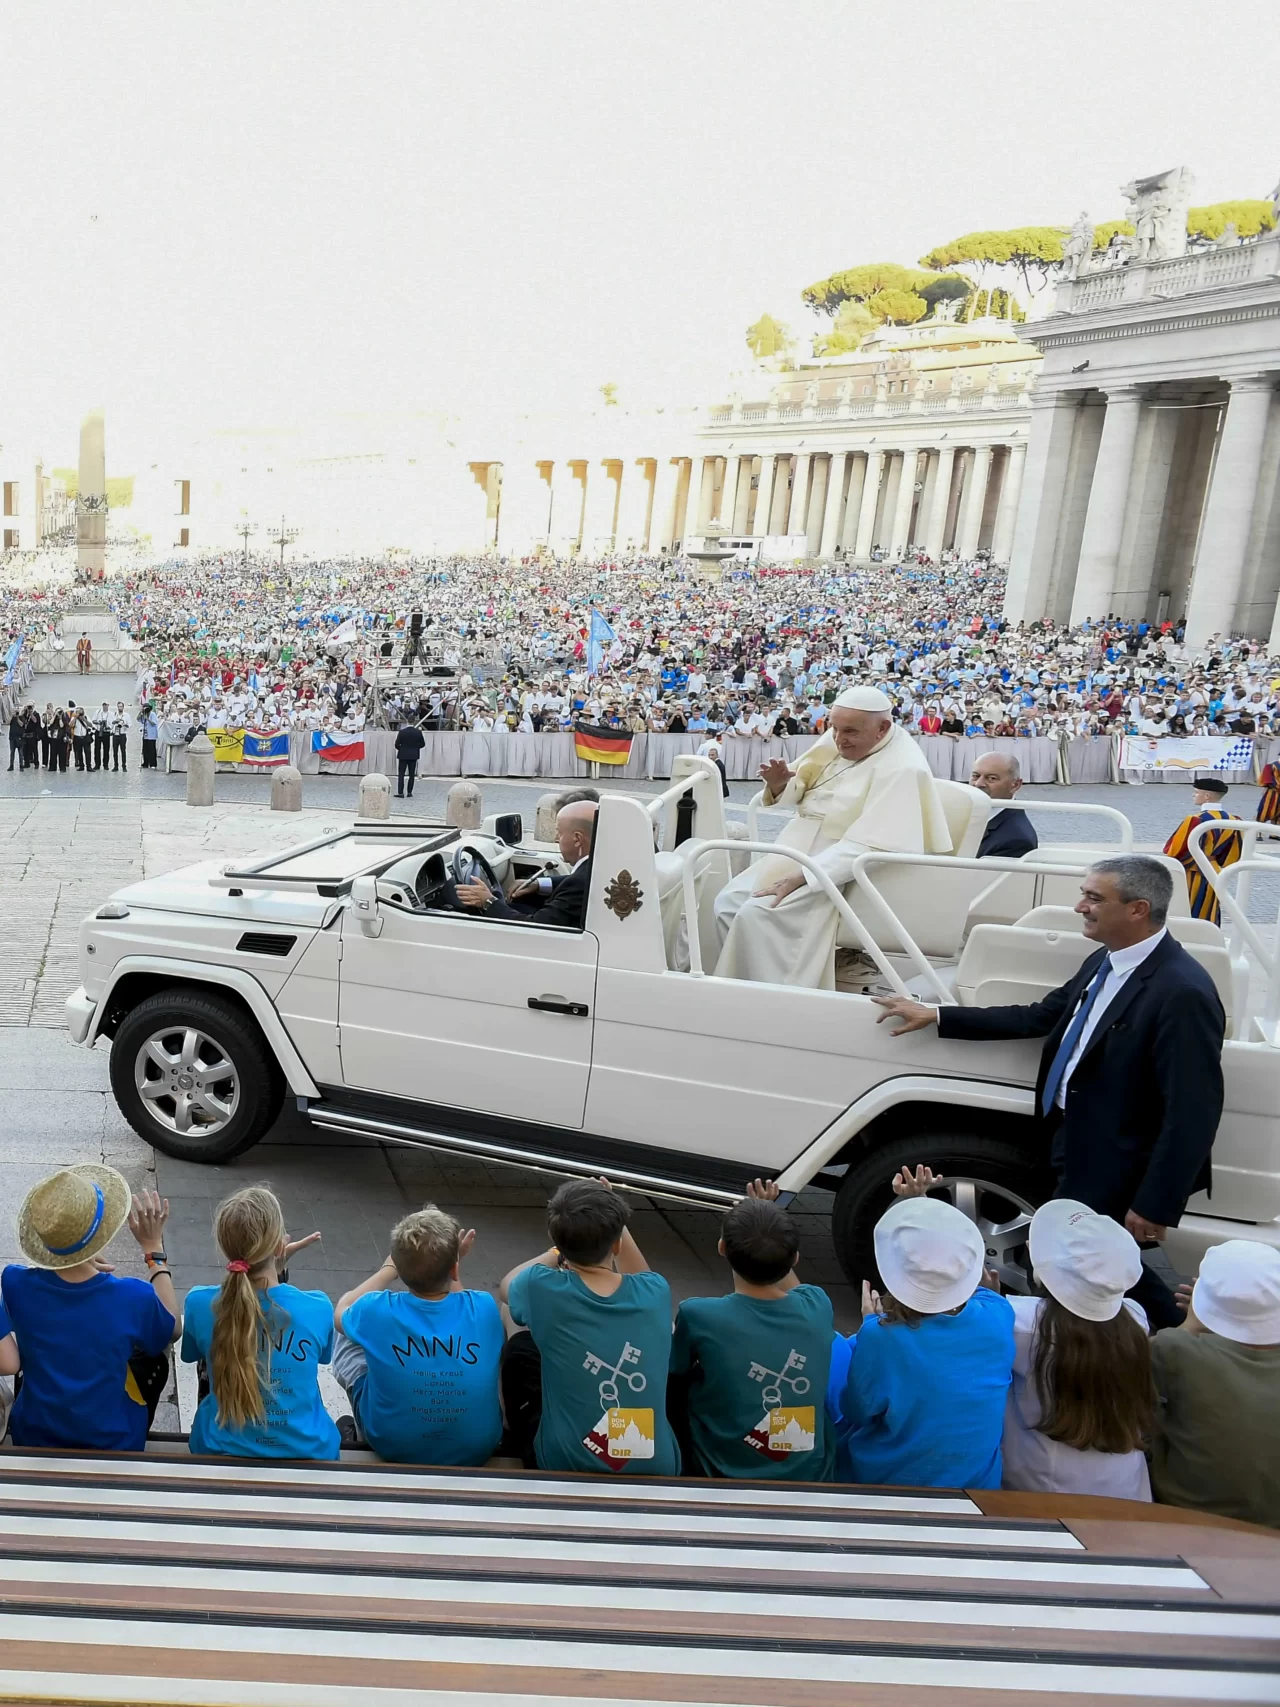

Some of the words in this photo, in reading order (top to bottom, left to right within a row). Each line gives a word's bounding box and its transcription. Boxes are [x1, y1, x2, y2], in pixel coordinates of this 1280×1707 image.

[261, 1327, 312, 1362] NIS
[391, 1334, 481, 1367] MINIS
[413, 1370, 436, 1378] Heilig
[582, 1436, 604, 1455] MIT
[743, 1435, 764, 1450] MIT
[772, 1442, 793, 1450] DIR
[611, 1448, 632, 1456] DIR
